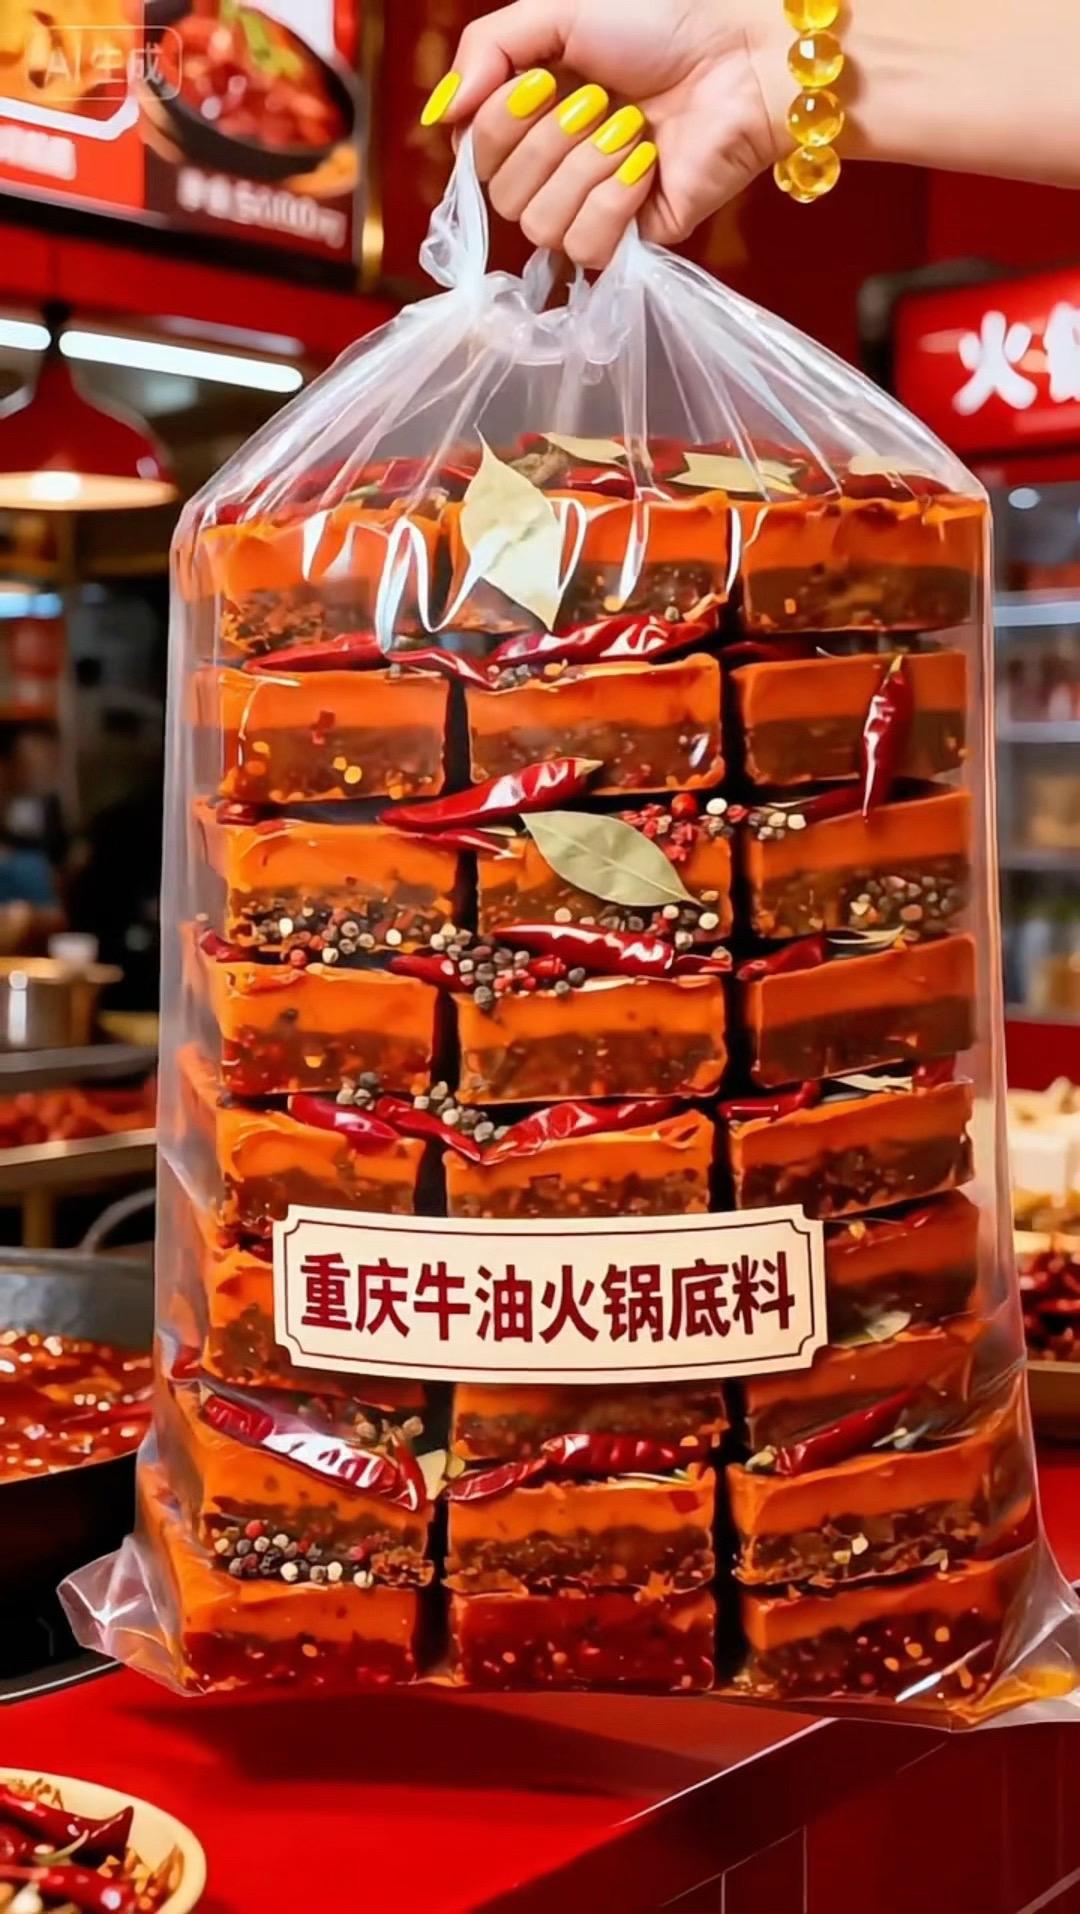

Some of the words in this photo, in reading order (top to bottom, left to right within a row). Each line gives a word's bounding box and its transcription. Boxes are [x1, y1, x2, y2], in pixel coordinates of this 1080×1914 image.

[299, 1250, 797, 1344] 重庆牛油火锅底料
